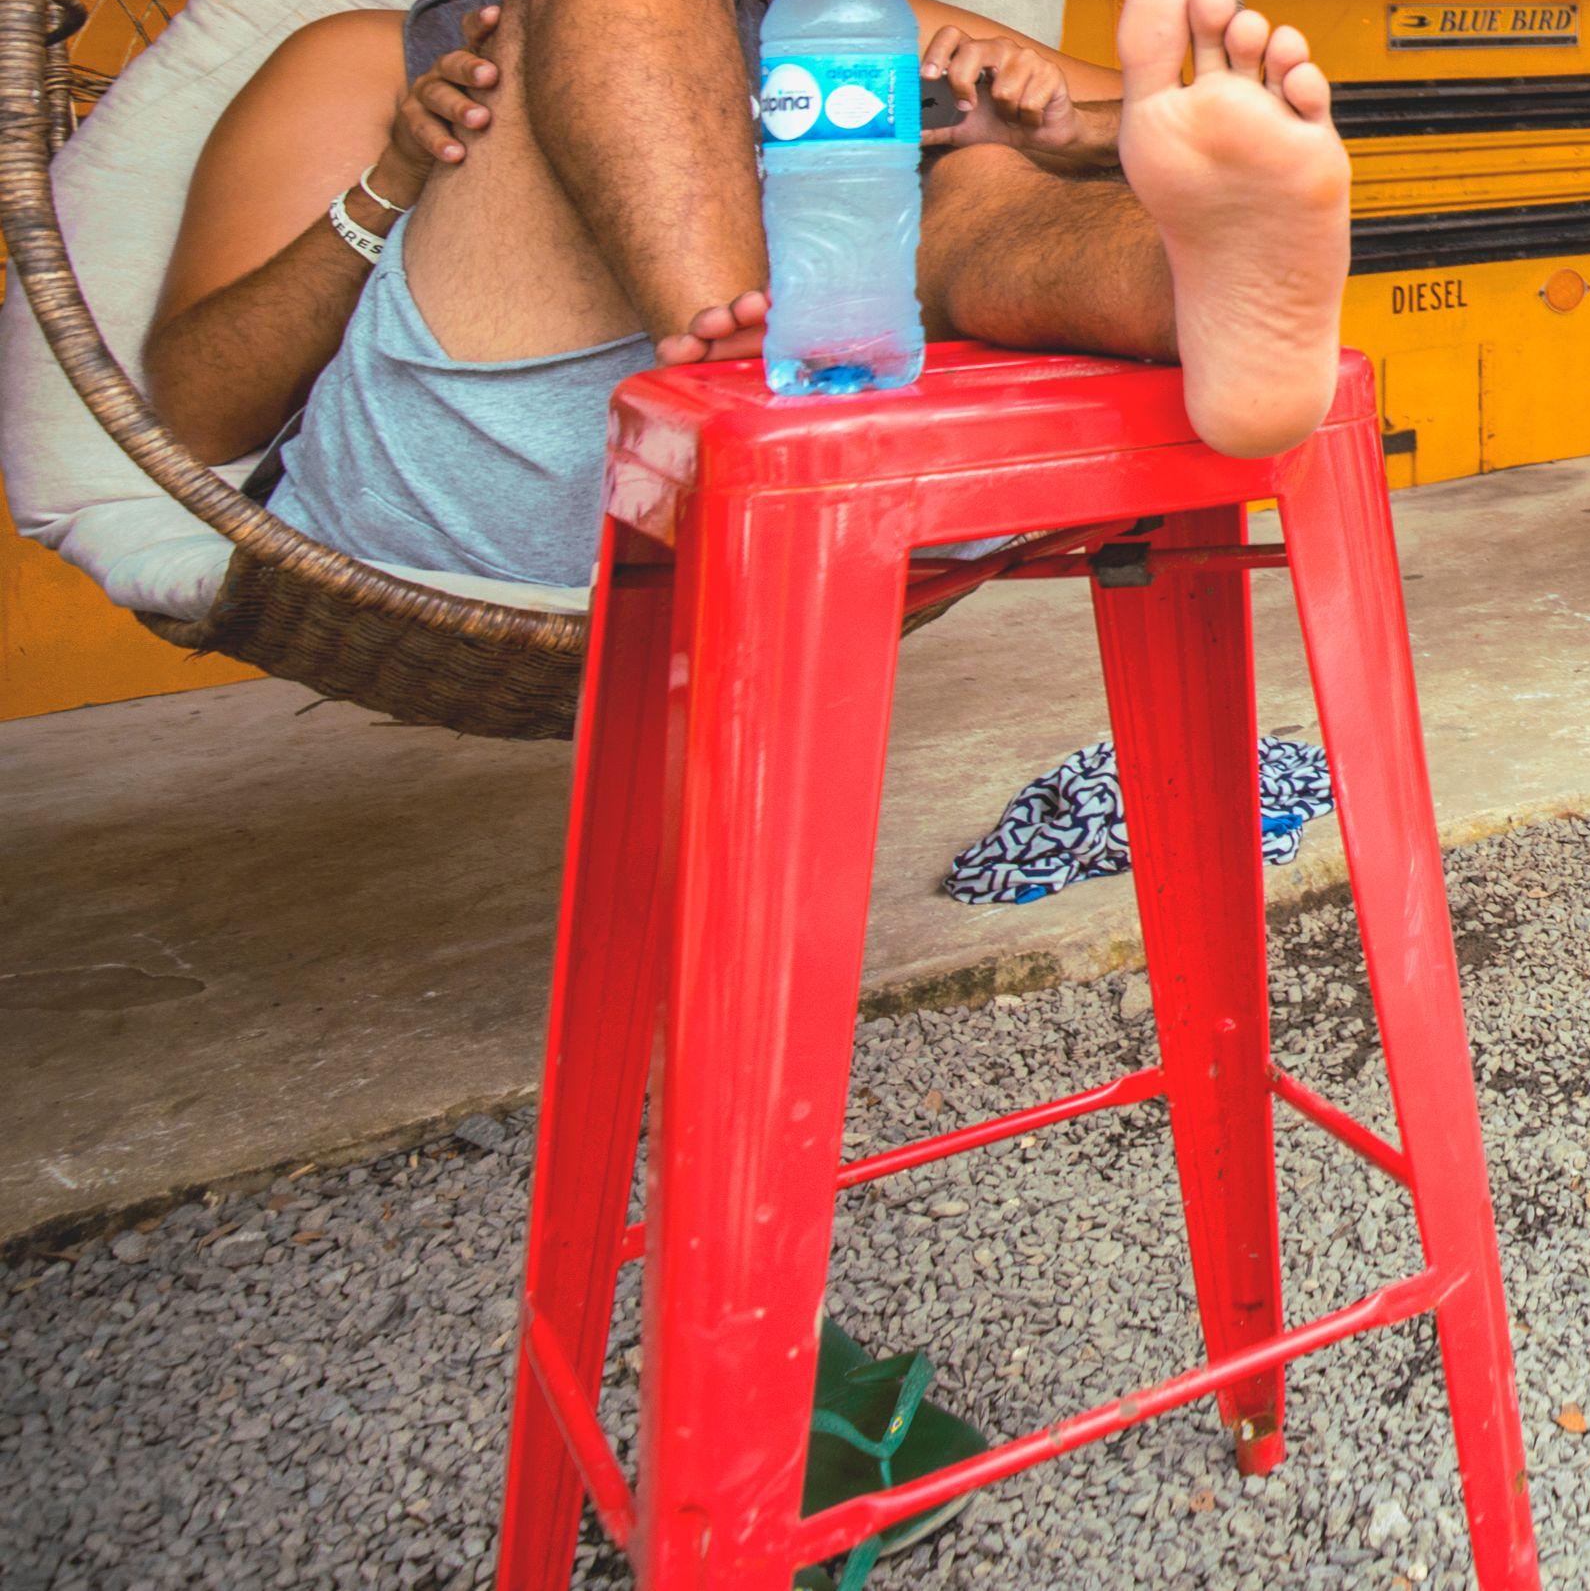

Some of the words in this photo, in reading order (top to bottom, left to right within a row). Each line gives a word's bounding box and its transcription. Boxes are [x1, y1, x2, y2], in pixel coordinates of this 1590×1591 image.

[1439, 9, 1502, 32] BLUE
[1511, 9, 1572, 31] BIRD
[1392, 279, 1469, 315] DIESEL
